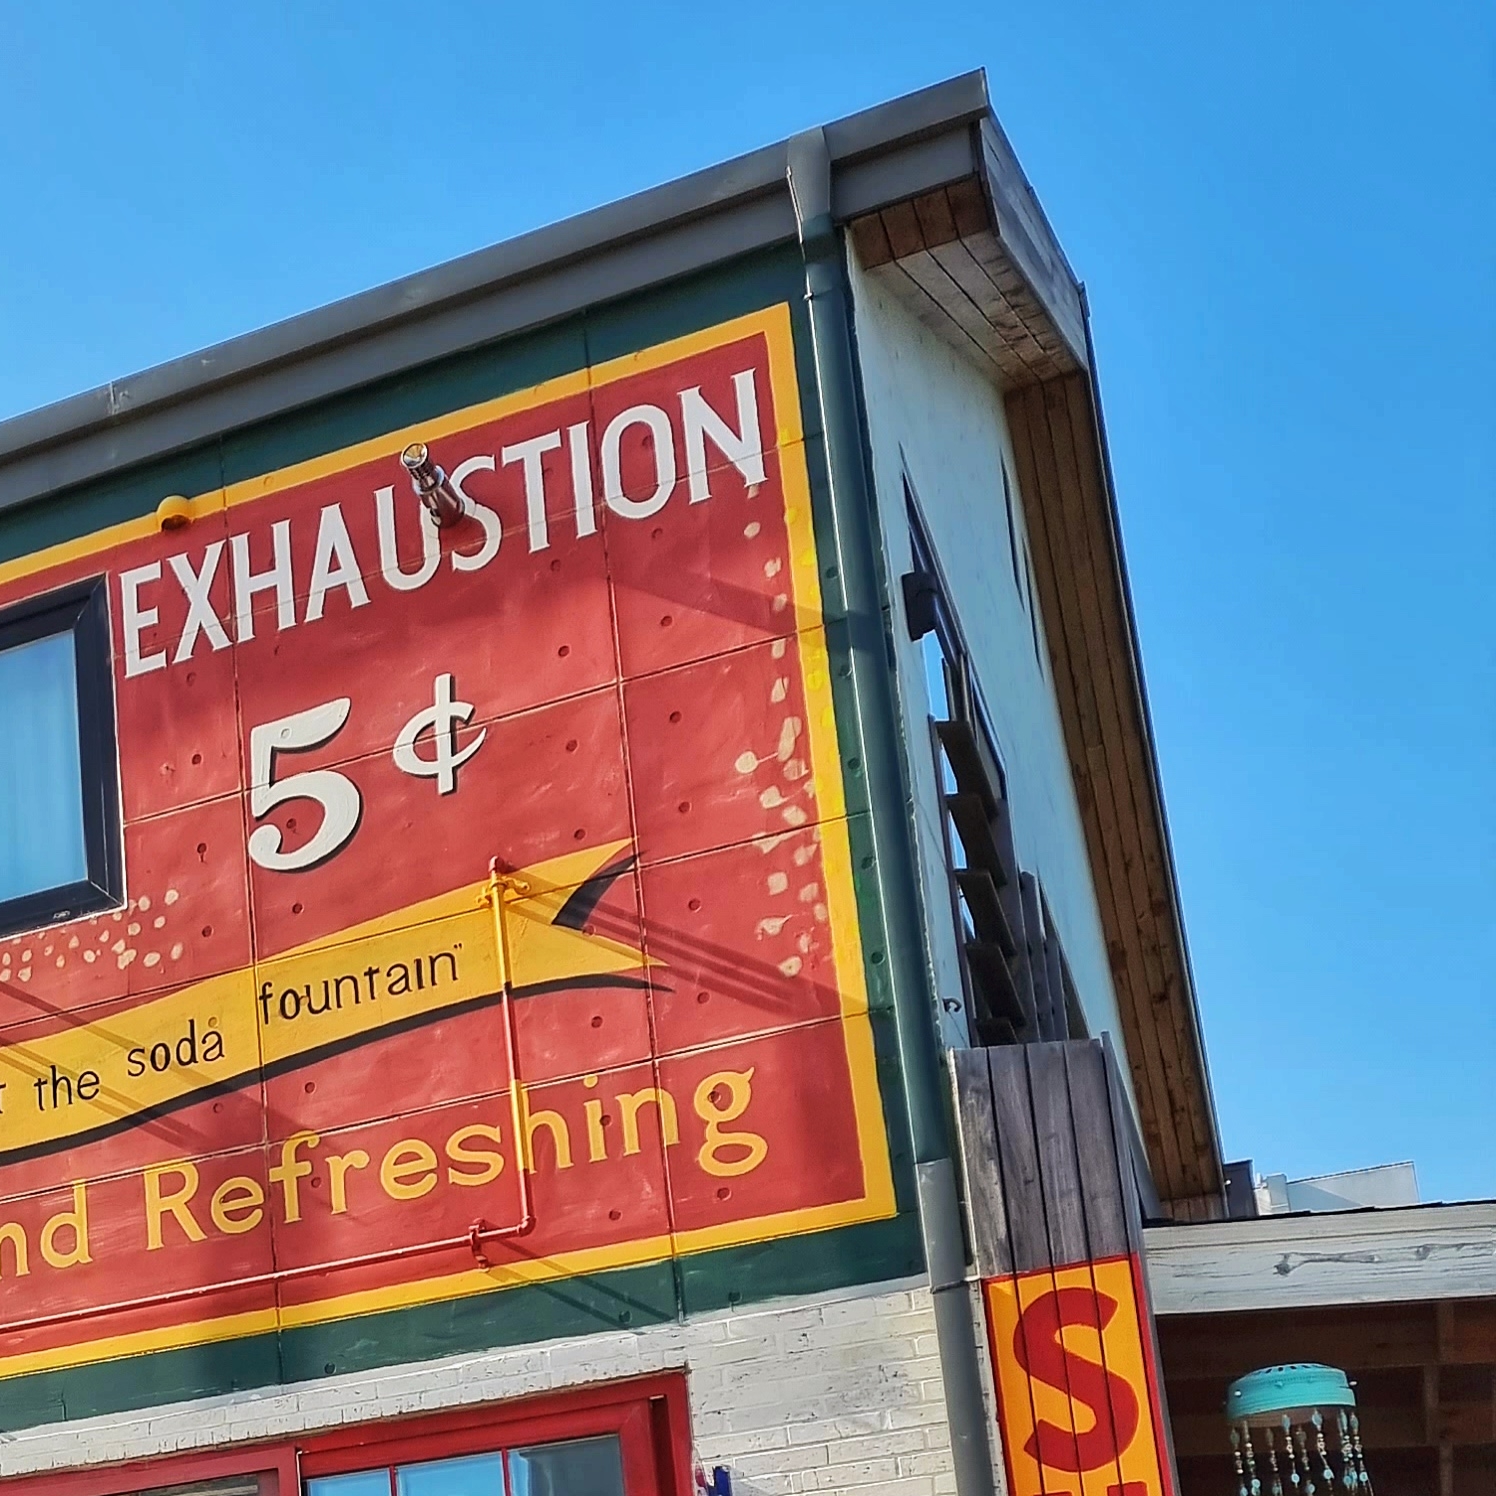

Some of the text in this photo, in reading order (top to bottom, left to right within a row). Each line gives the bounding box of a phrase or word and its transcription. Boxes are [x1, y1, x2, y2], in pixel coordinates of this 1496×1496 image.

[118, 367, 770, 679] EXHAUSTION
[33, 1065, 100, 1112] the
[127, 1019, 225, 1077] soda
[143, 1067, 767, 1250] Refreshing
